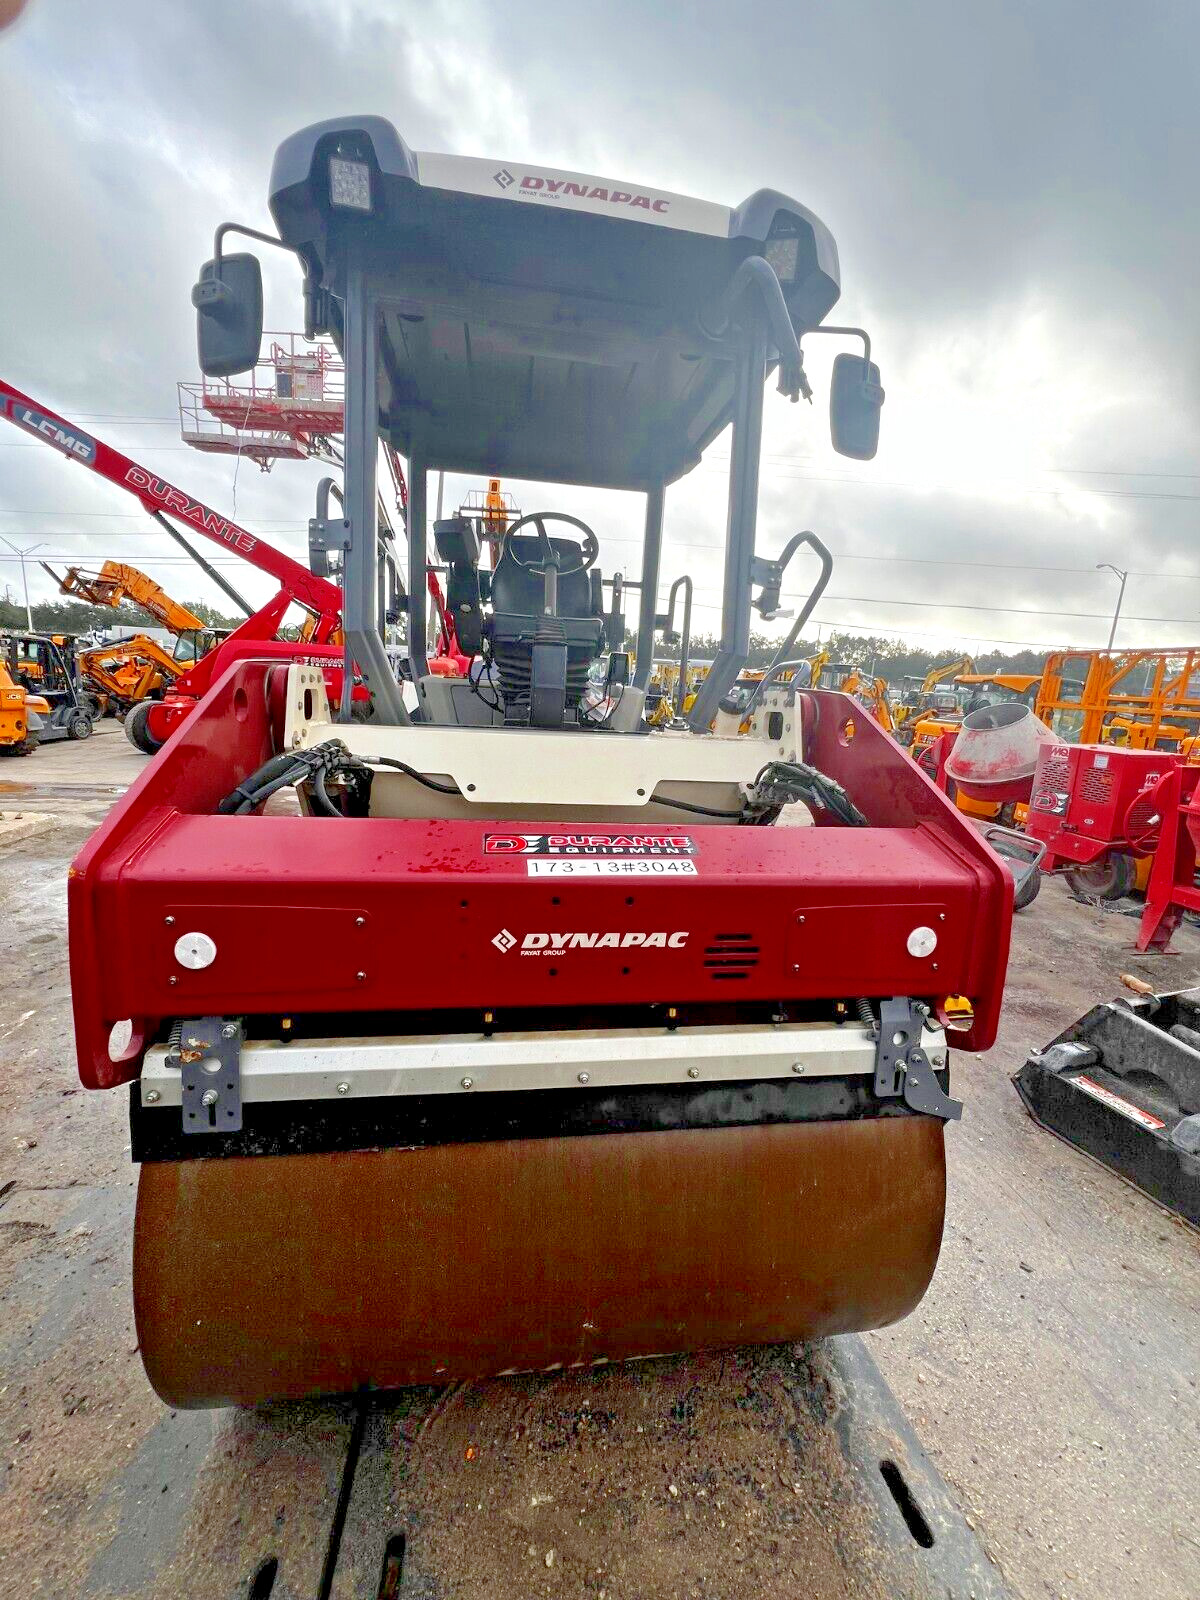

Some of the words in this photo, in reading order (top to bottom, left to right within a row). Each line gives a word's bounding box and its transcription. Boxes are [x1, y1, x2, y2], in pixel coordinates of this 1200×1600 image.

[519, 176, 671, 213] DYNAPAC
[22, 410, 92, 458] LCMG
[124, 466, 256, 552] DURANTE
[548, 836, 692, 847] DURANTE
[531, 862, 695, 873] 173-13#3048
[520, 931, 690, 949] DYNAPAC
